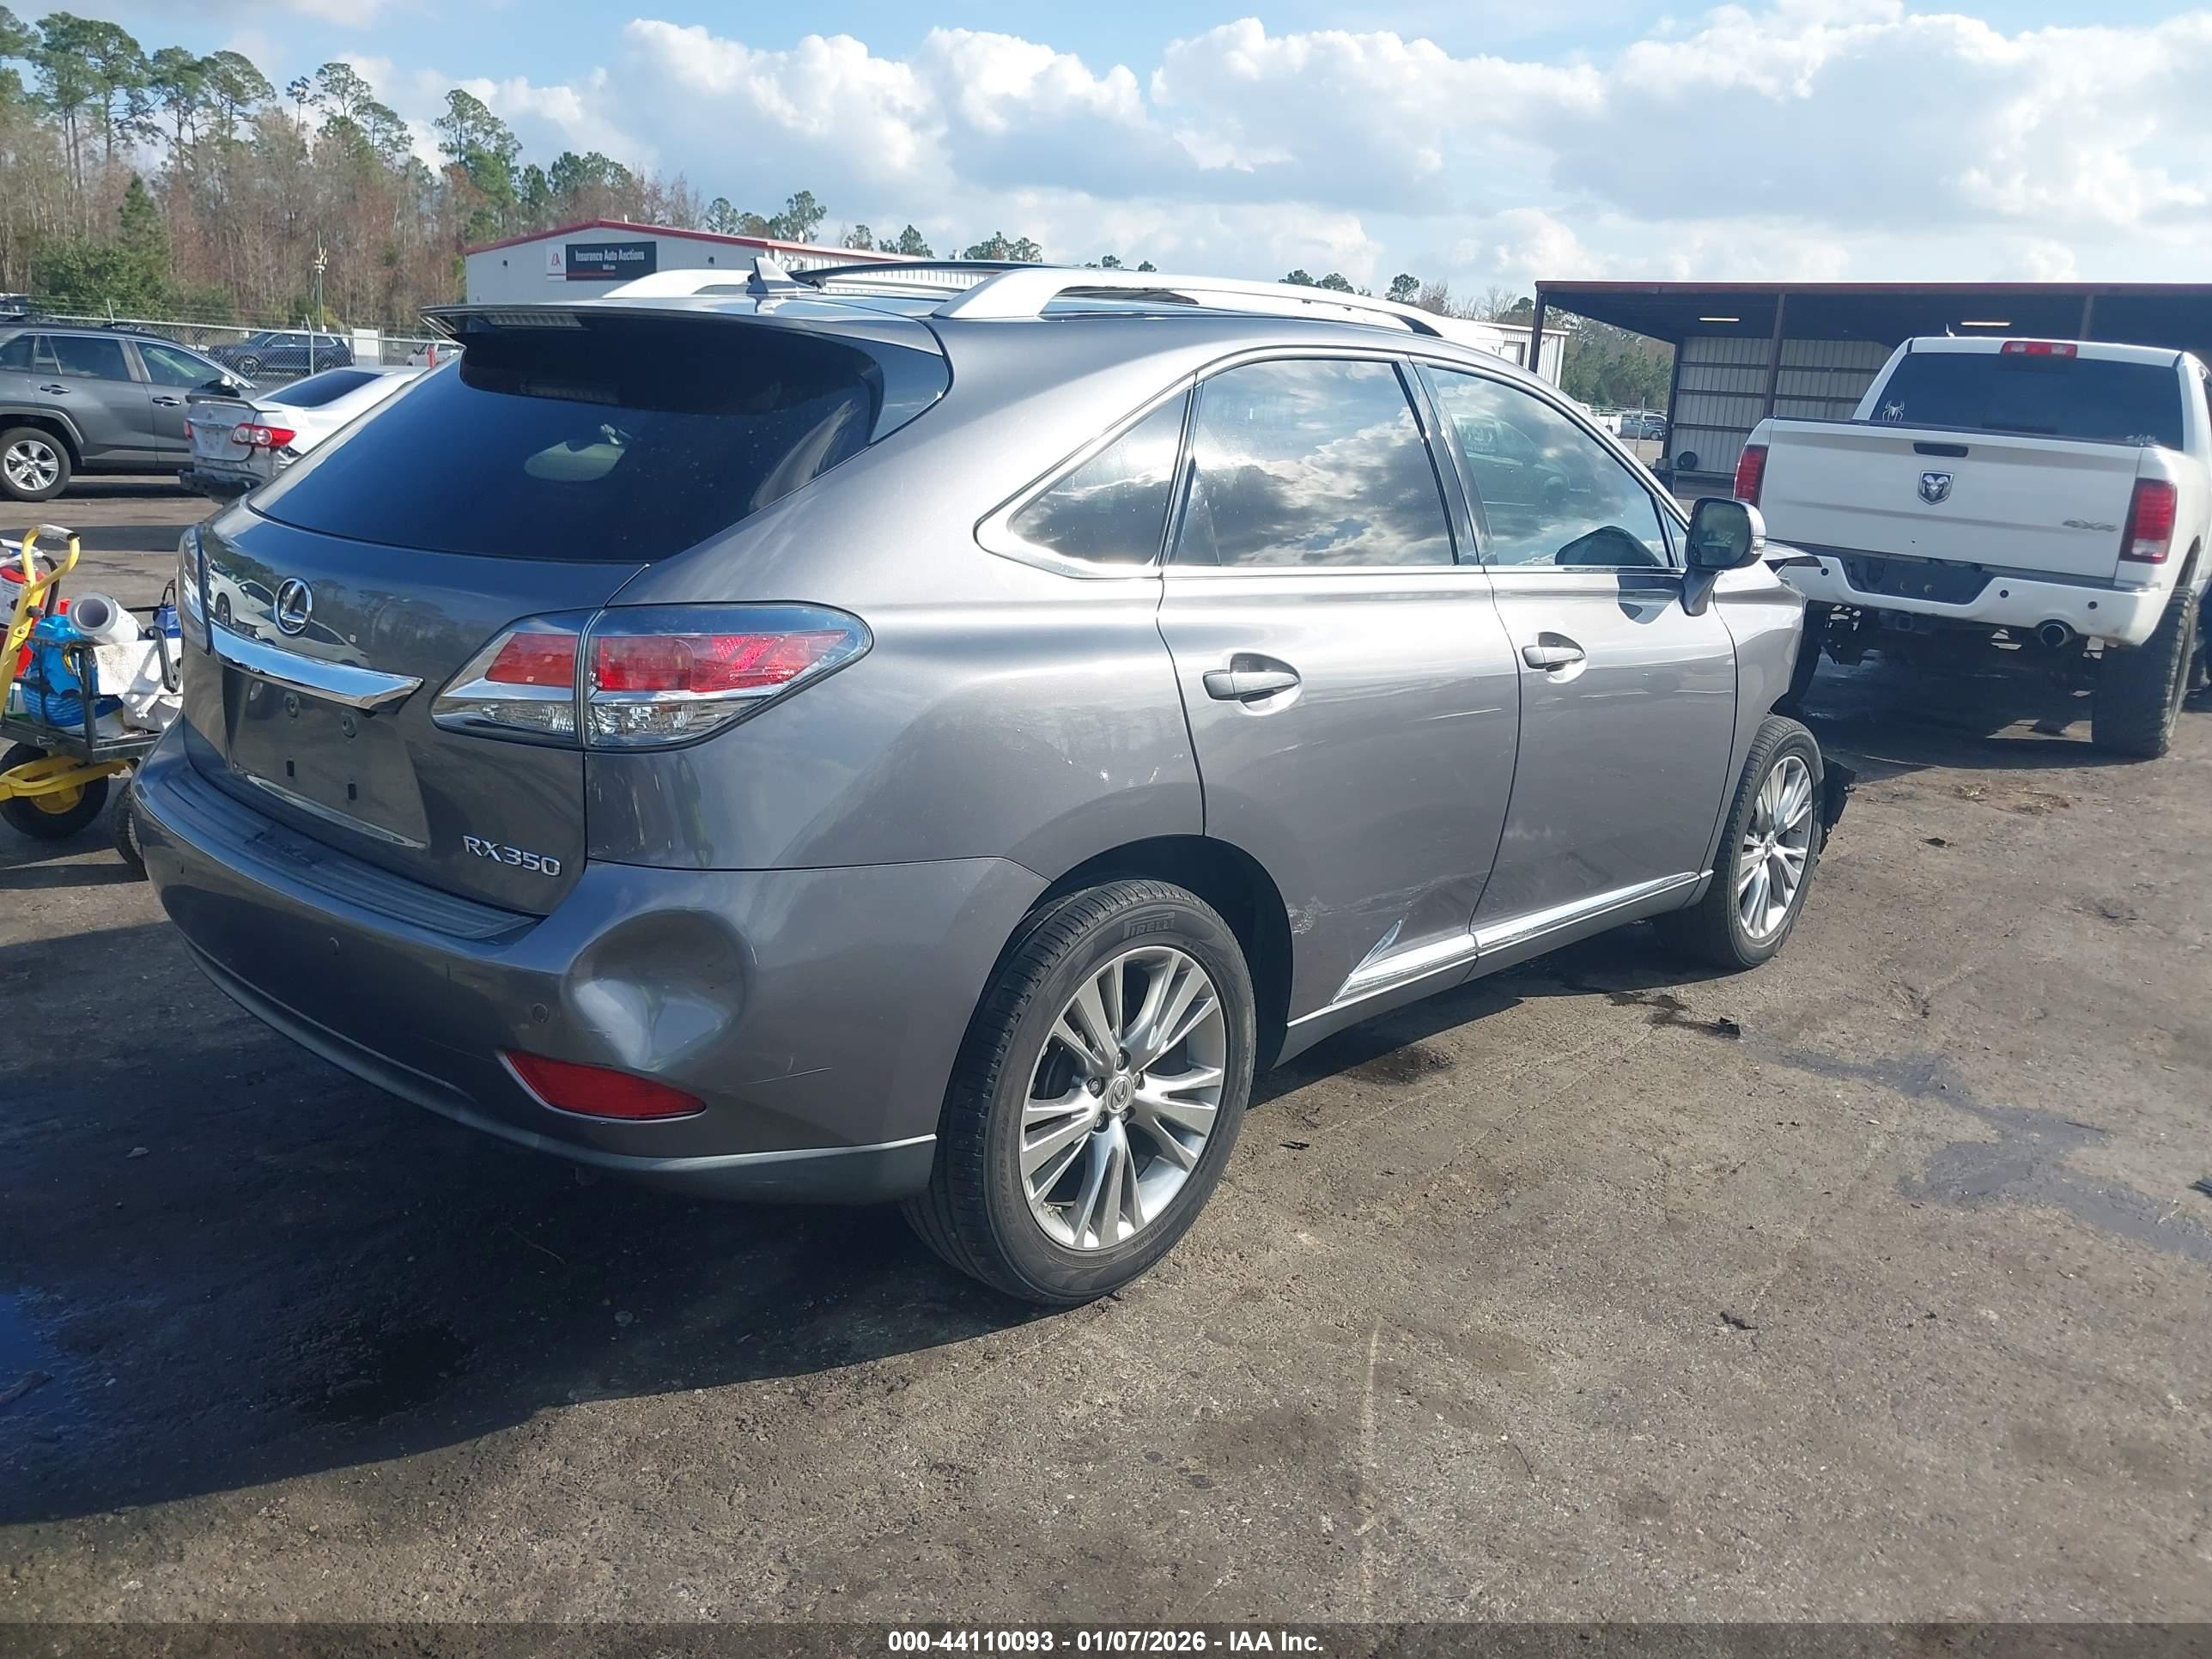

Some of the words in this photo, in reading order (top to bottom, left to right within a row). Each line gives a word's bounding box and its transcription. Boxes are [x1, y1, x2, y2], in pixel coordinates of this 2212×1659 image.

[575, 250, 603, 261] Insurance
[604, 249, 617, 261] Auto
[618, 249, 645, 261] Auctions
[1123, 912, 1175, 939] PIRELLI
